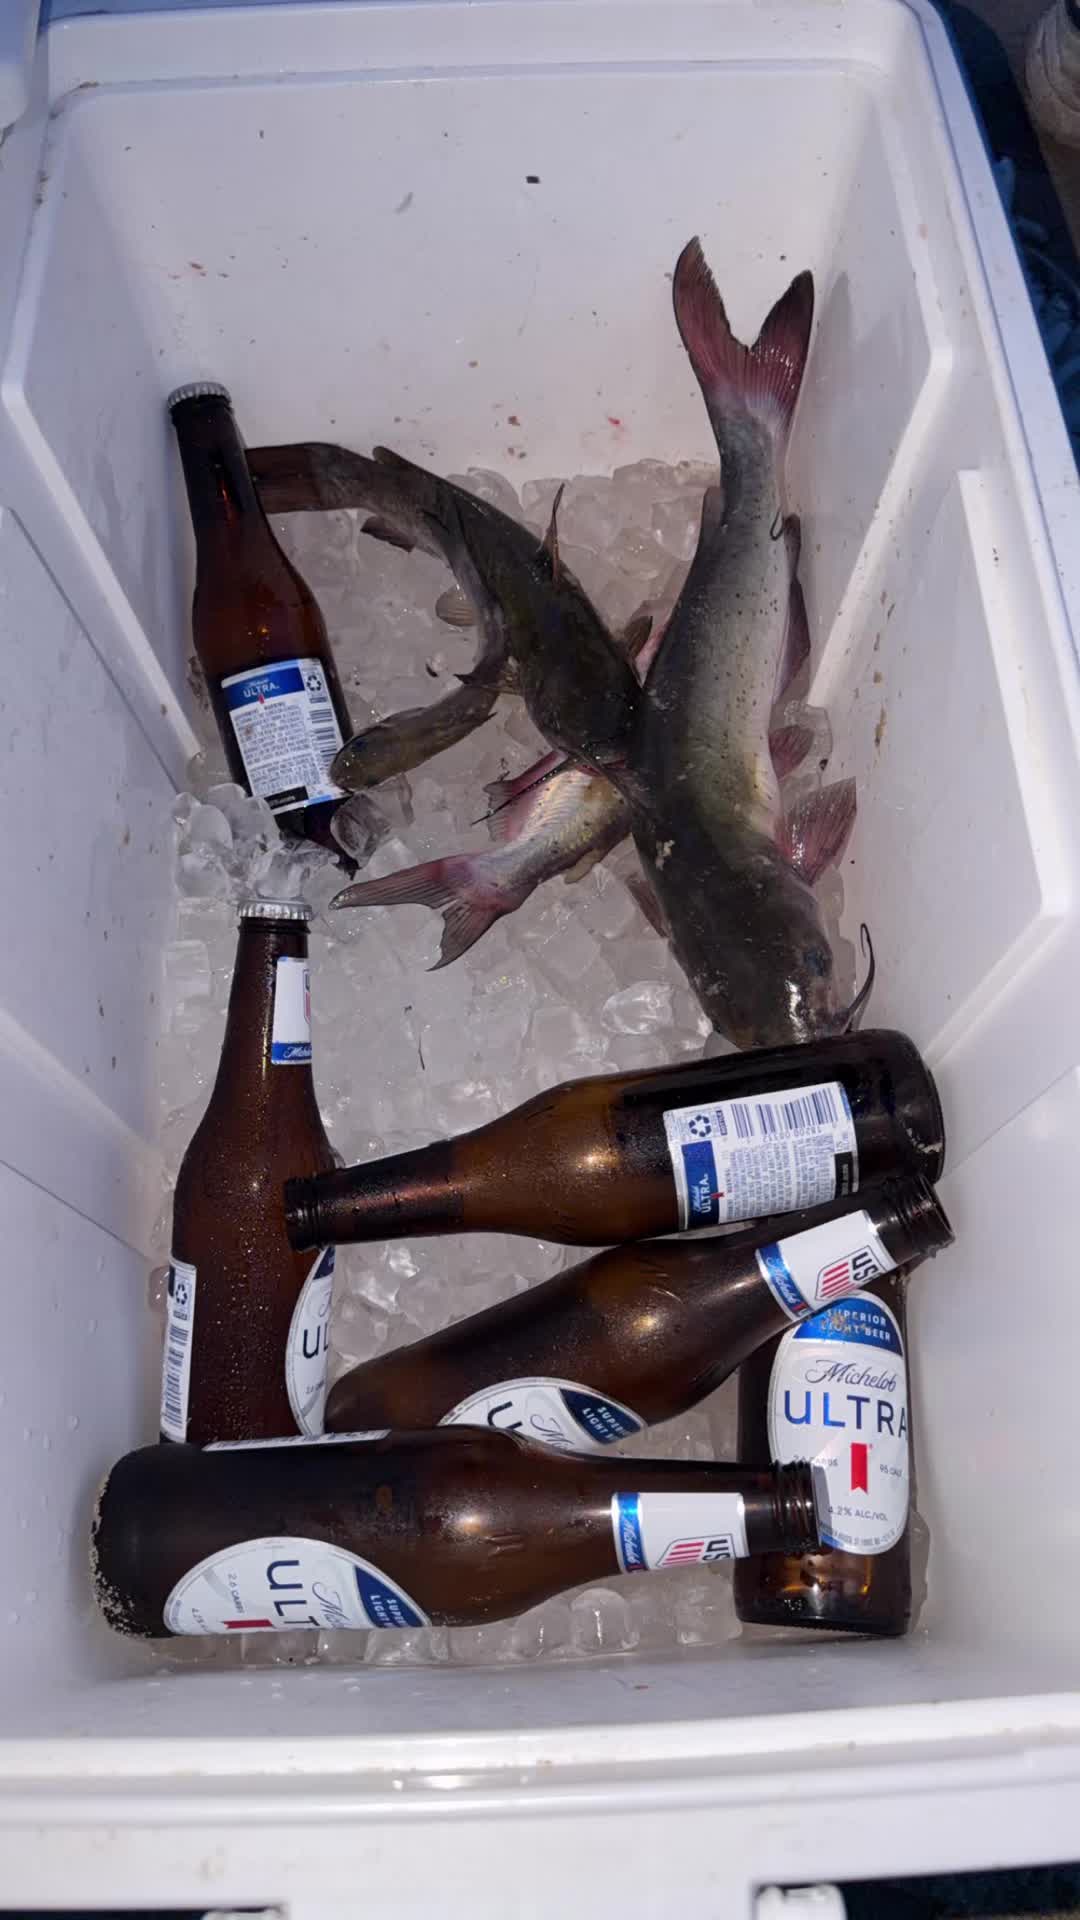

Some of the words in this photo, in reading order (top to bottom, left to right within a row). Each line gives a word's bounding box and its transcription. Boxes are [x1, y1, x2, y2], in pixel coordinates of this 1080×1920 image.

[701, 1178, 711, 1213] ULTRA
[852, 1252, 878, 1281] US
[828, 1309, 887, 1327] SUPERIOR
[865, 1327, 891, 1341] BEER
[805, 1359, 898, 1392] Michelob
[784, 1390, 907, 1438] ULTRA
